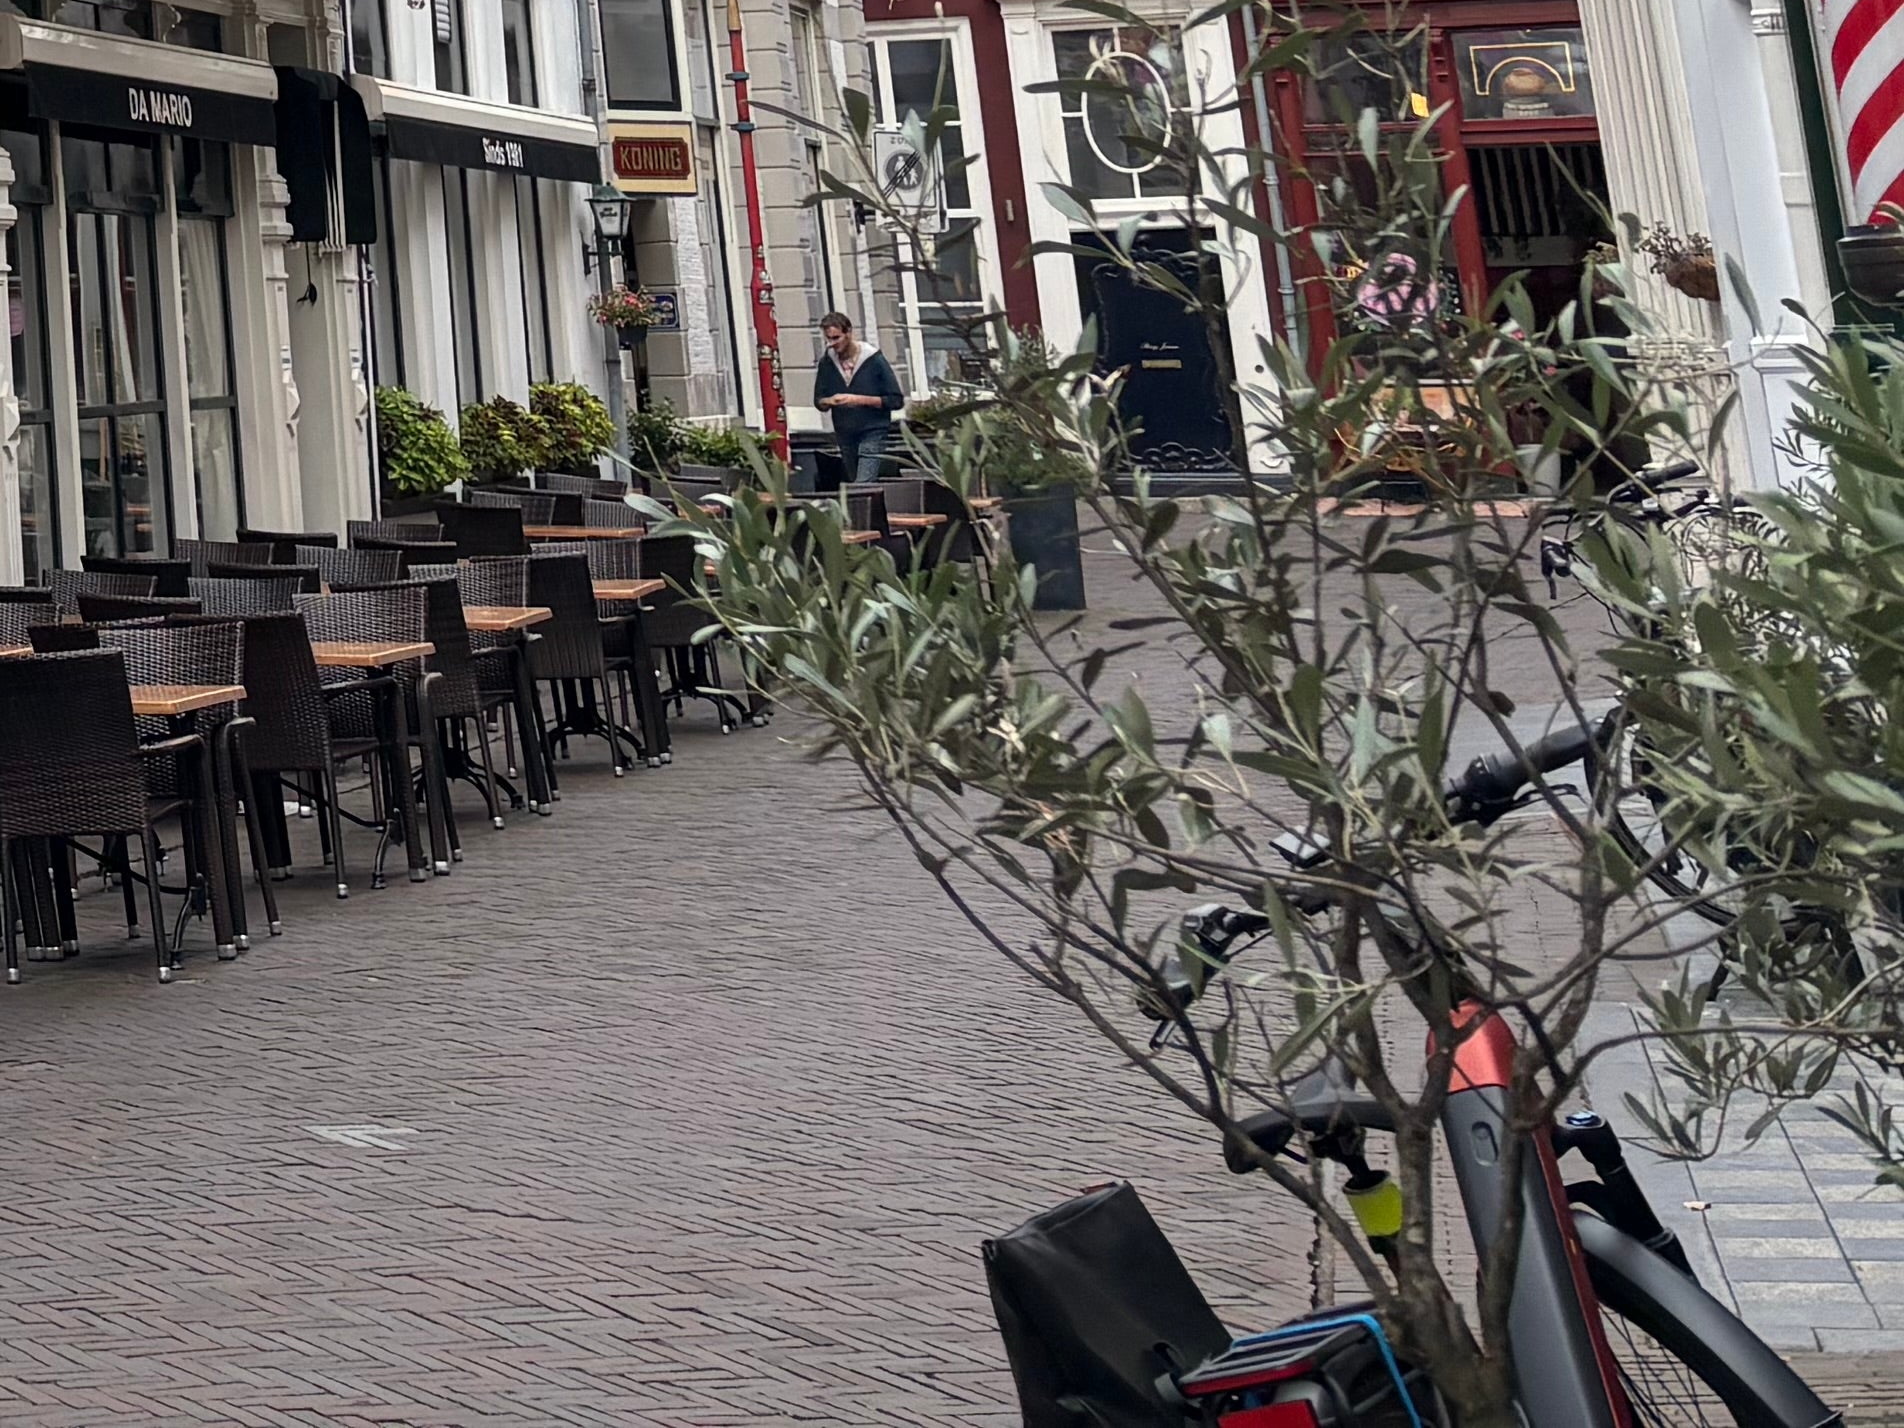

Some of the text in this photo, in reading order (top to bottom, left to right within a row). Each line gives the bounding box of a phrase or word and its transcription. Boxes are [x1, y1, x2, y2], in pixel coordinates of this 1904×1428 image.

[128, 88, 193, 127] DA MARIO
[620, 145, 682, 172] KONING
